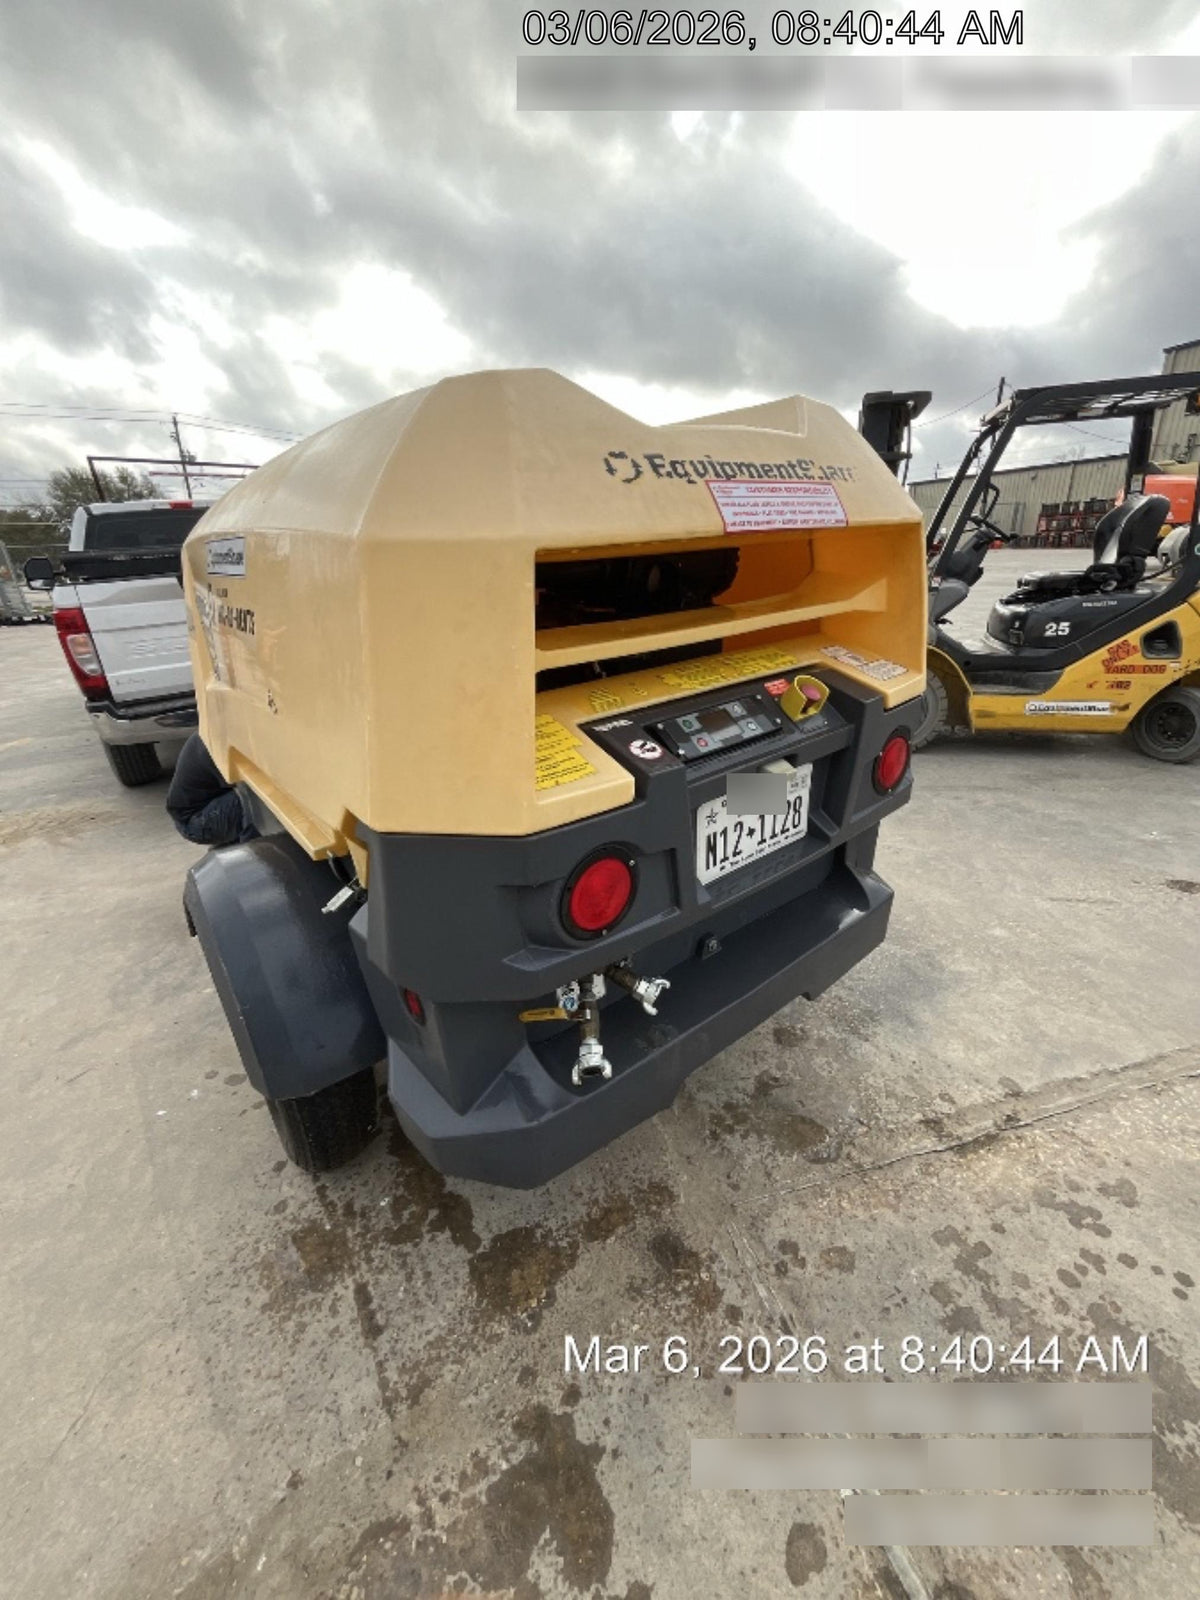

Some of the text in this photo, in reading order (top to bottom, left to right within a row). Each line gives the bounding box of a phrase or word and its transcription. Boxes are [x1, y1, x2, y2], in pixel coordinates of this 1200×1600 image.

[1044, 622, 1071, 637] 25
[1104, 664, 1167, 674] YARD DOG
[705, 796, 803, 871] N12 1128
